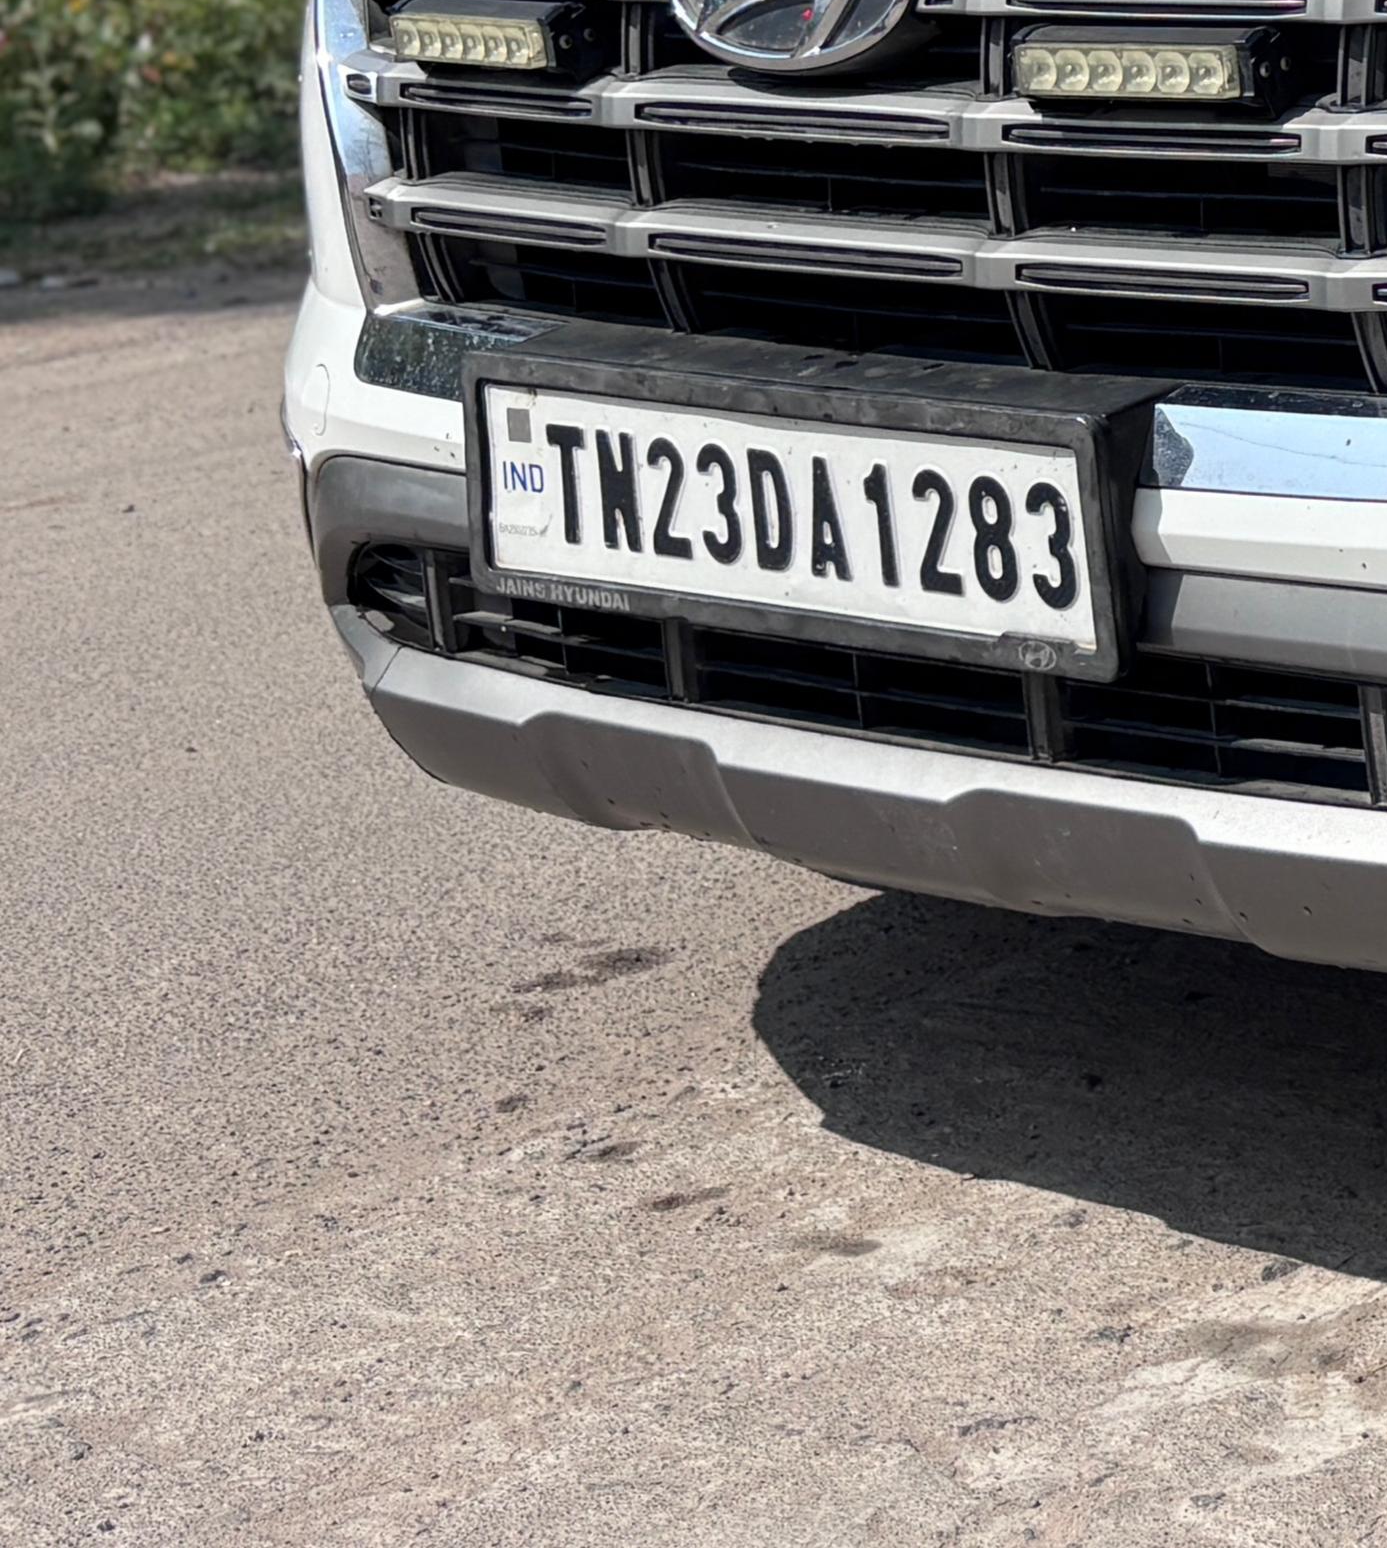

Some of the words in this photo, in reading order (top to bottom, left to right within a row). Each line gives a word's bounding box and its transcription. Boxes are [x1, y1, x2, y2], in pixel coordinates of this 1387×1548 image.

[502, 460, 545, 493] IND
[546, 423, 1079, 610] TN23DA1283
[496, 577, 546, 599] JAINS
[550, 584, 631, 611] HYUNDAI
